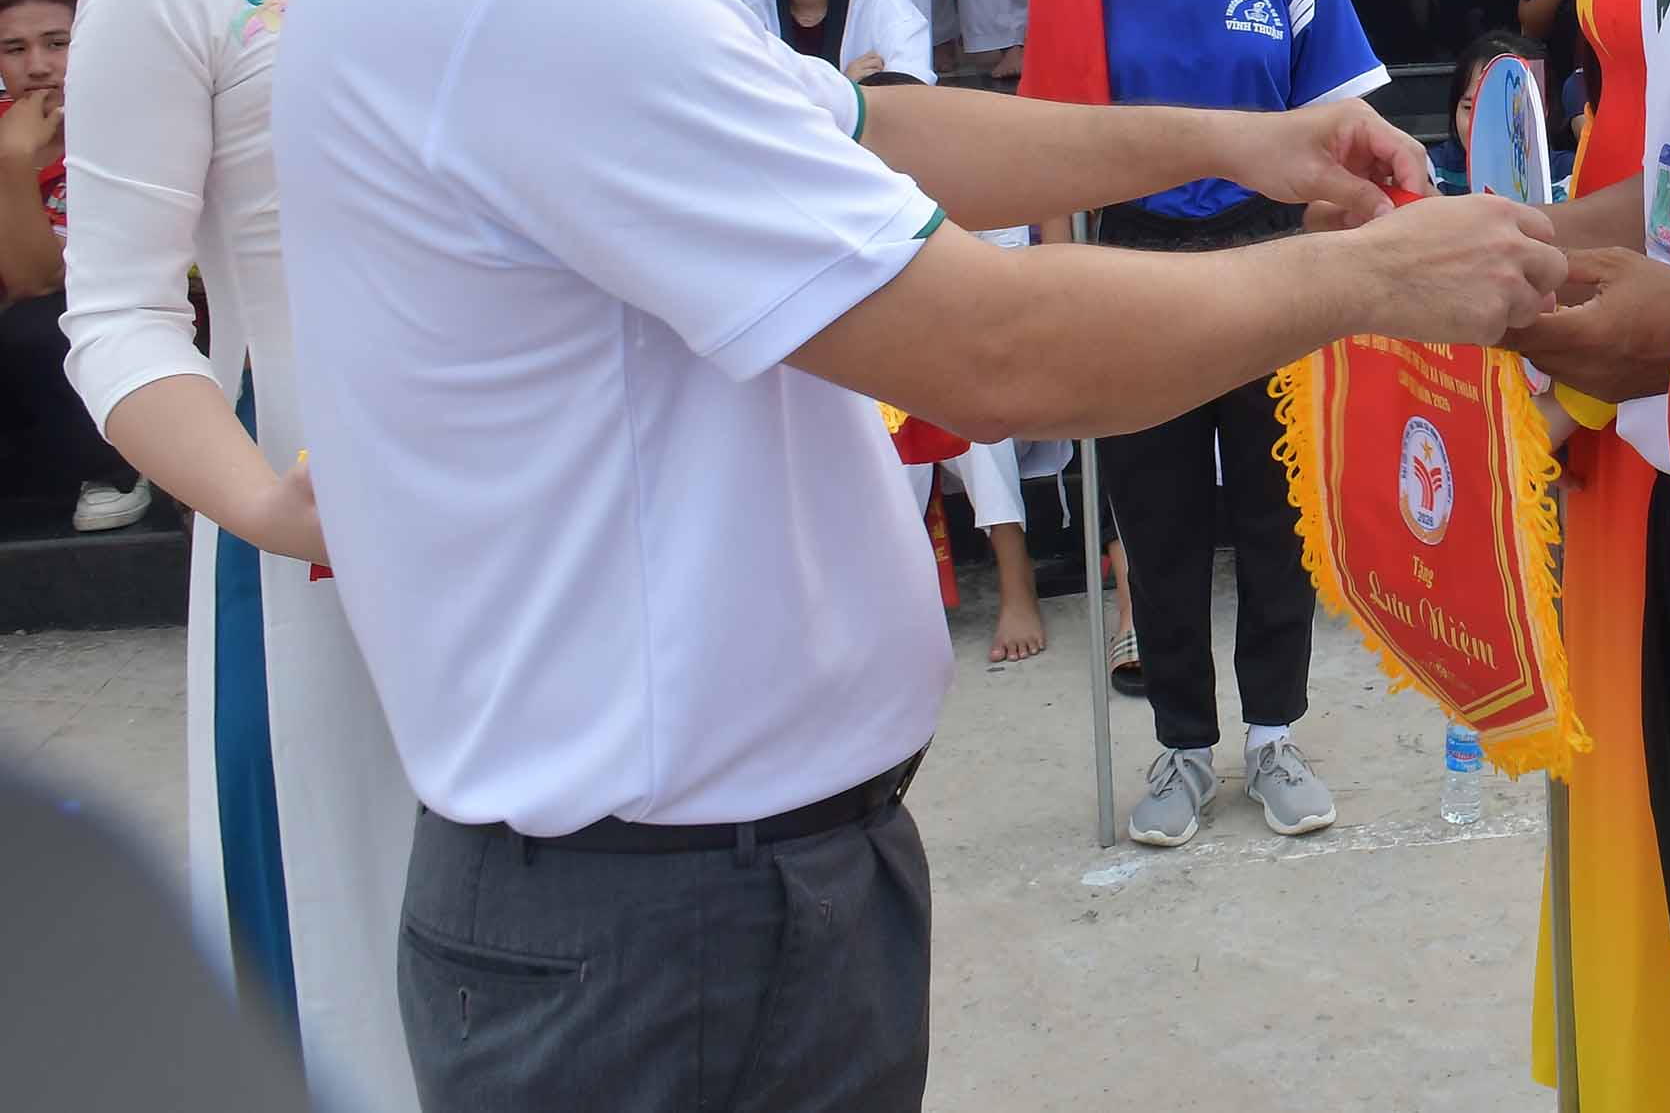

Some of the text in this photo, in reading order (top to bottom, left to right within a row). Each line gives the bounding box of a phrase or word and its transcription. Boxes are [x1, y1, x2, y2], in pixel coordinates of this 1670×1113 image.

[1412, 554, 1435, 590] Tặng
[1368, 570, 1498, 671] Lưu Niệm
